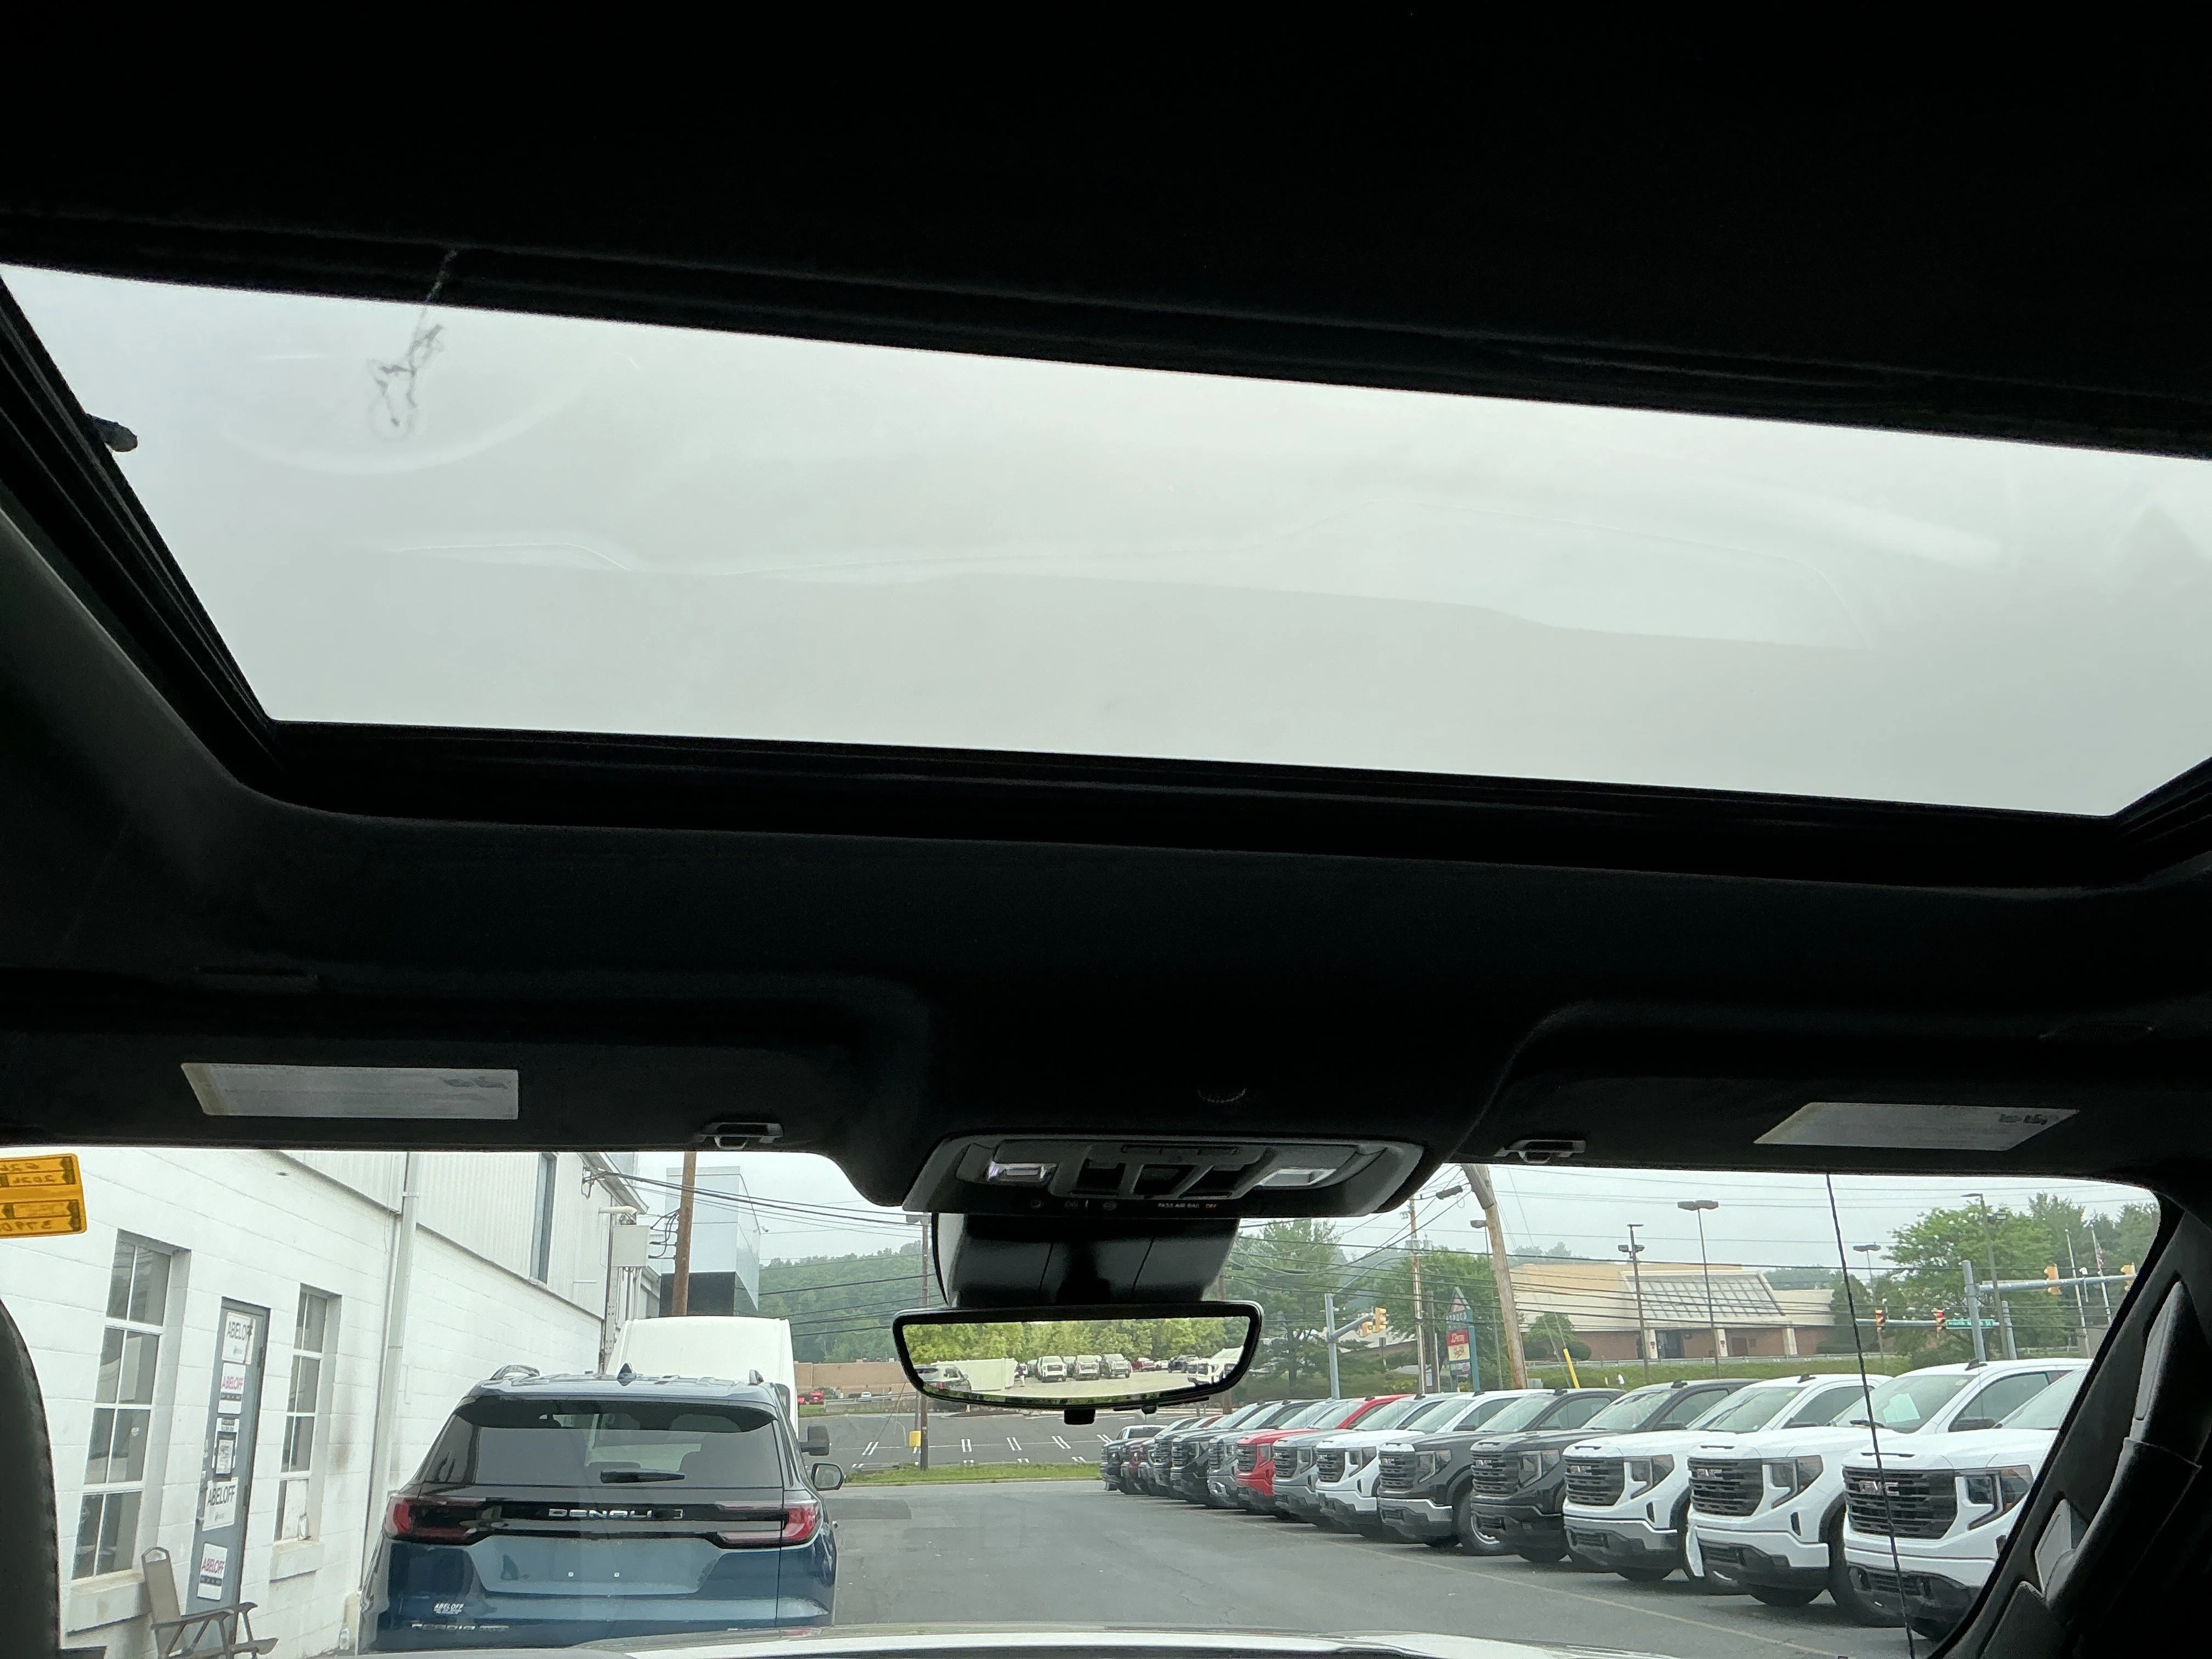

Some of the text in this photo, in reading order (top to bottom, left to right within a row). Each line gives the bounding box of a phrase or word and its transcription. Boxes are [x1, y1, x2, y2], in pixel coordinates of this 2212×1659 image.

[207, 1485, 236, 1506] ABELOFF
[1859, 1481, 1900, 1496] GMC
[549, 1509, 653, 1519] DENALI
